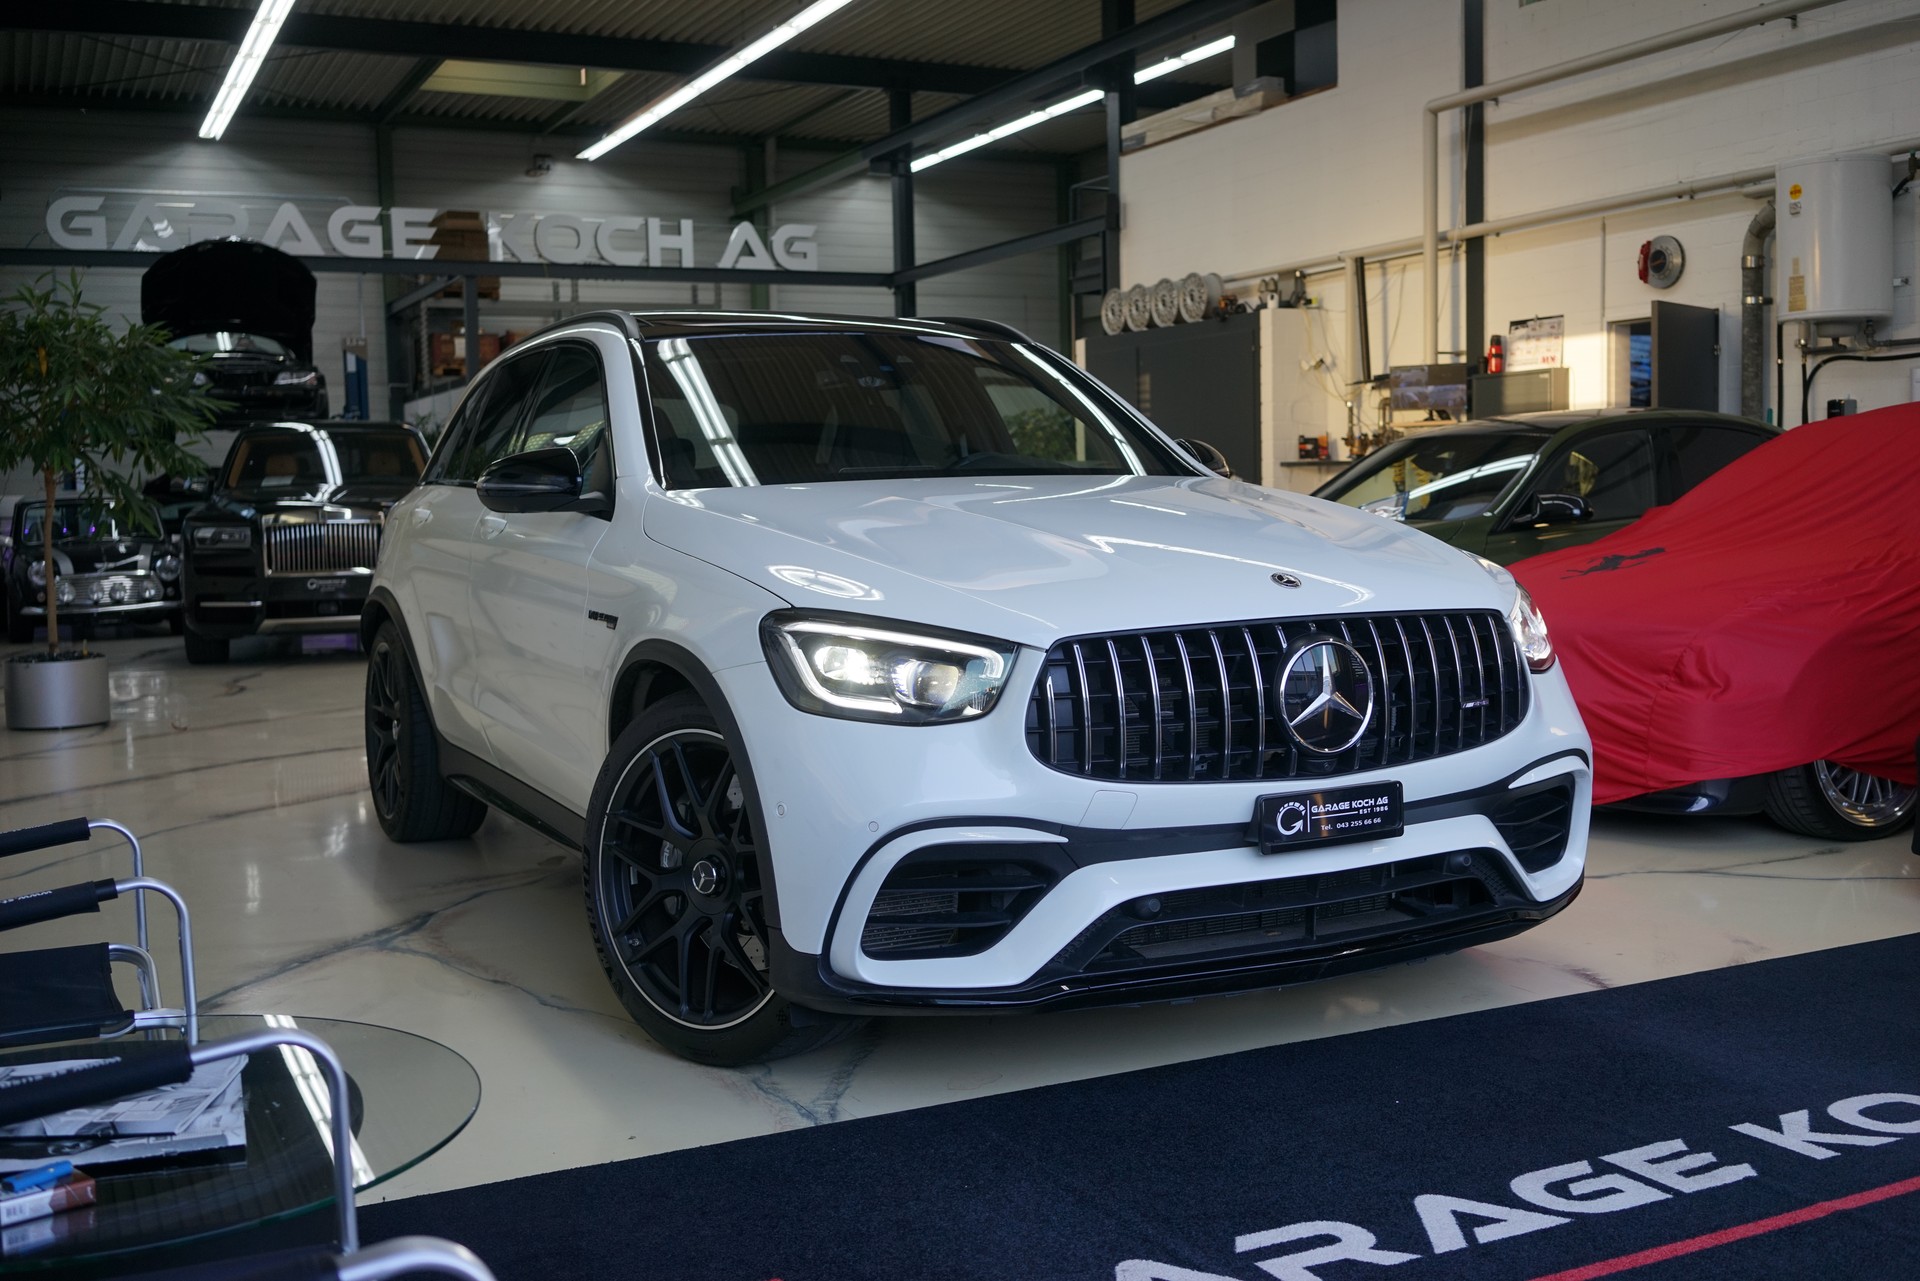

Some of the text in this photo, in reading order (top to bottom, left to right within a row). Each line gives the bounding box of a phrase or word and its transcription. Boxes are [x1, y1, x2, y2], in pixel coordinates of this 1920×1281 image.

[46, 196, 818, 271] GARAGE KOCH AG
[1311, 796, 1388, 813] GARAGE KOCH AG
[1336, 821, 1349, 829] 043
